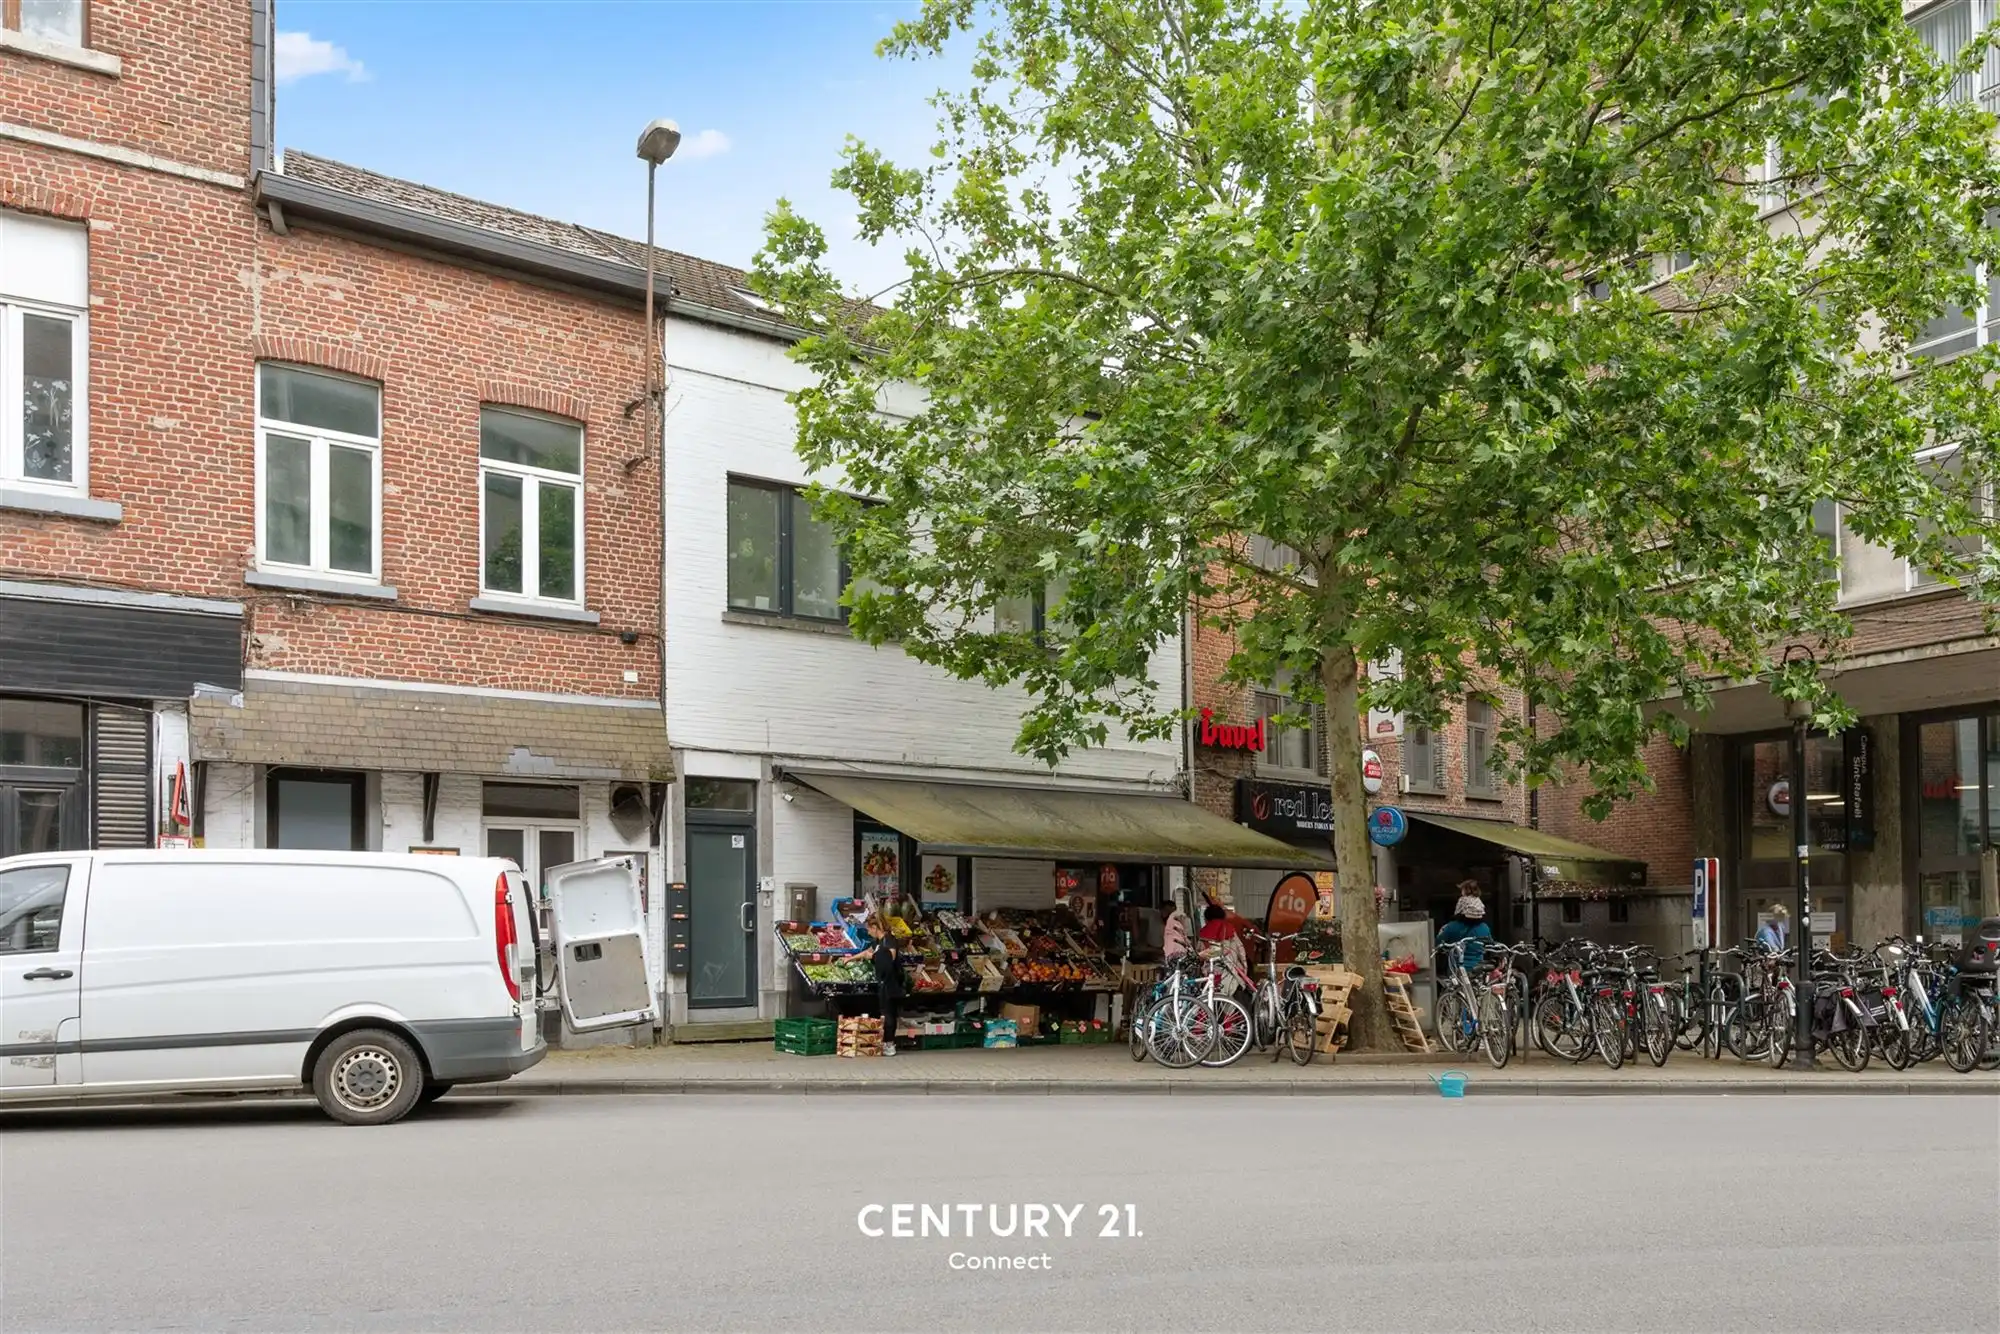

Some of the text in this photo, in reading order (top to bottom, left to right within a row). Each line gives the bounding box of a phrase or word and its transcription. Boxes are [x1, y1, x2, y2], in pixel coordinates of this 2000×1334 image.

[1201, 706, 1265, 752] Duvel
[1860, 735, 1868, 775] Campus
[1274, 791, 1307, 818] red
[1278, 888, 1306, 914] ria
[1694, 868, 1704, 909] P
